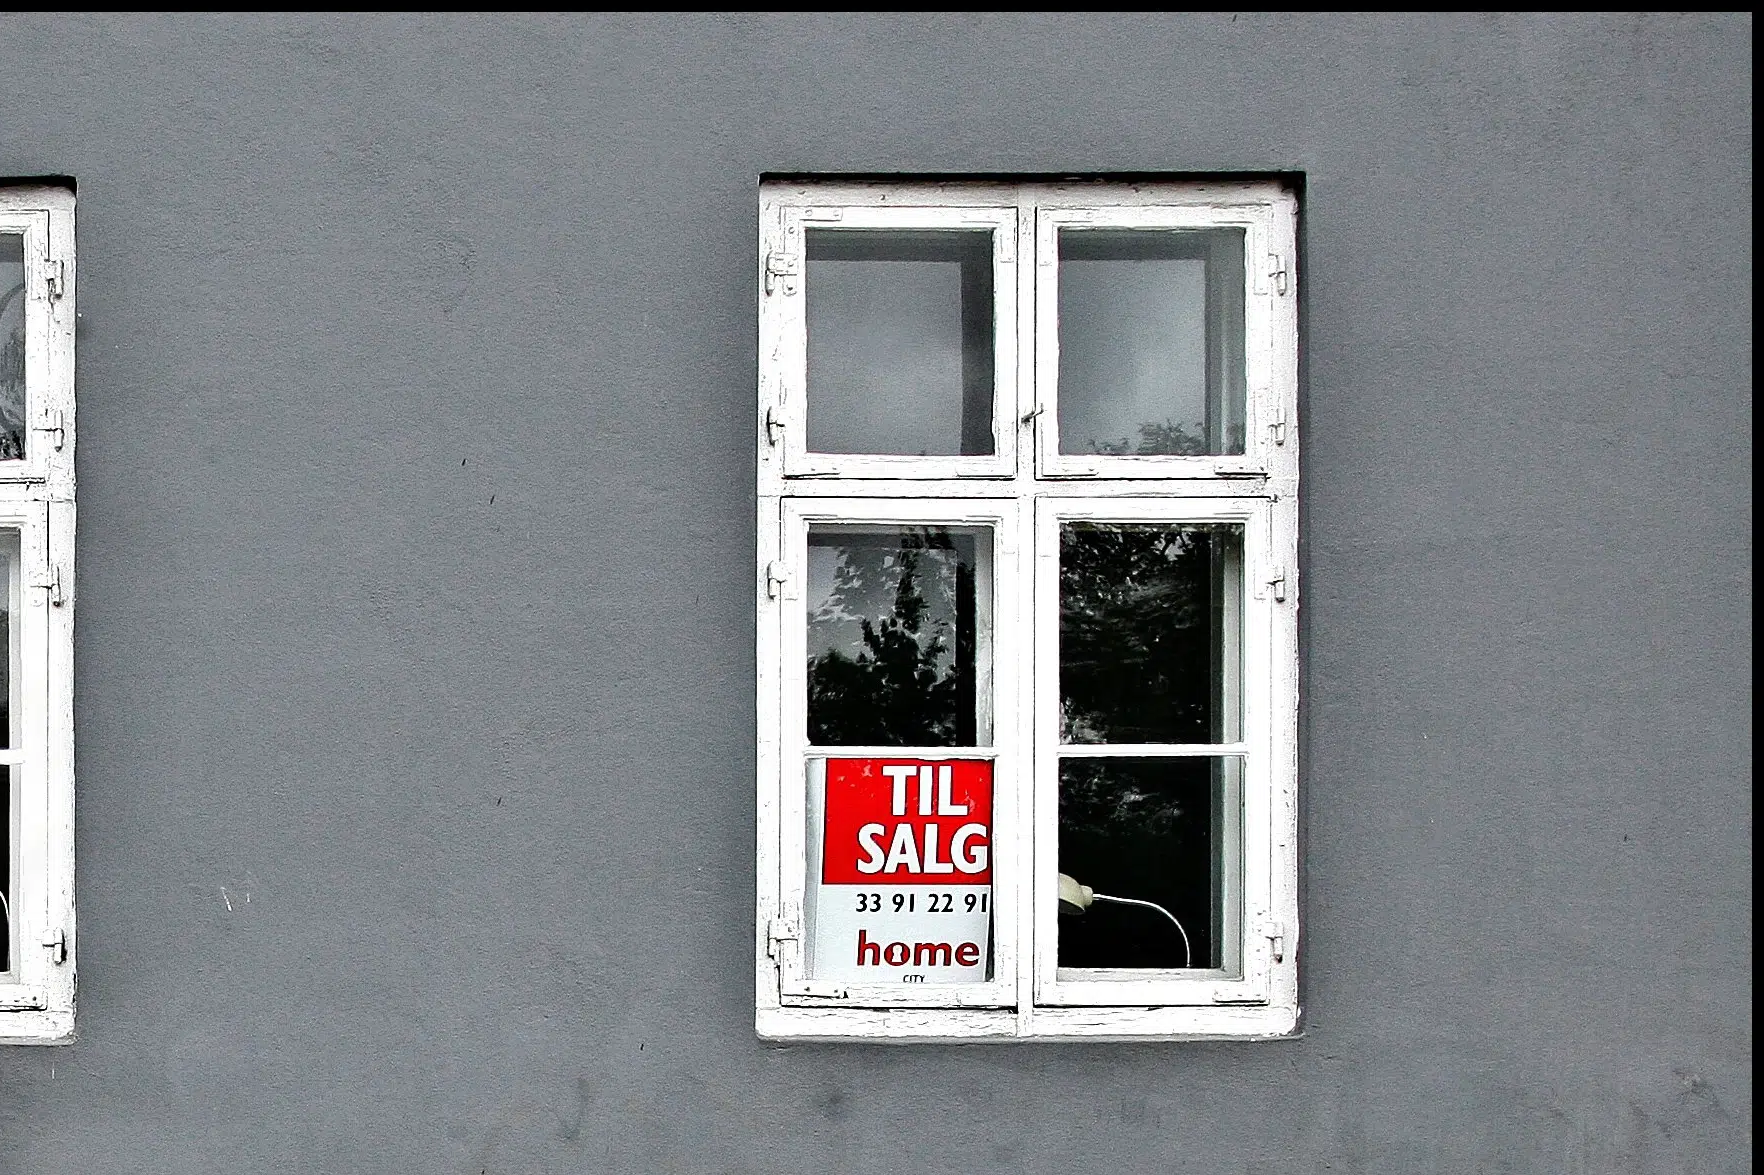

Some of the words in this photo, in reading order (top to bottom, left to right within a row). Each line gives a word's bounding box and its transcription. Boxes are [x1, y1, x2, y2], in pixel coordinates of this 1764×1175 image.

[882, 765, 968, 816] TIL
[857, 822, 988, 874] SALG
[855, 893, 882, 913] 33
[892, 893, 915, 913] 91
[927, 893, 954, 913] 22
[964, 893, 987, 913] 91
[857, 929, 980, 967] home
[903, 974, 925, 984] CITY
